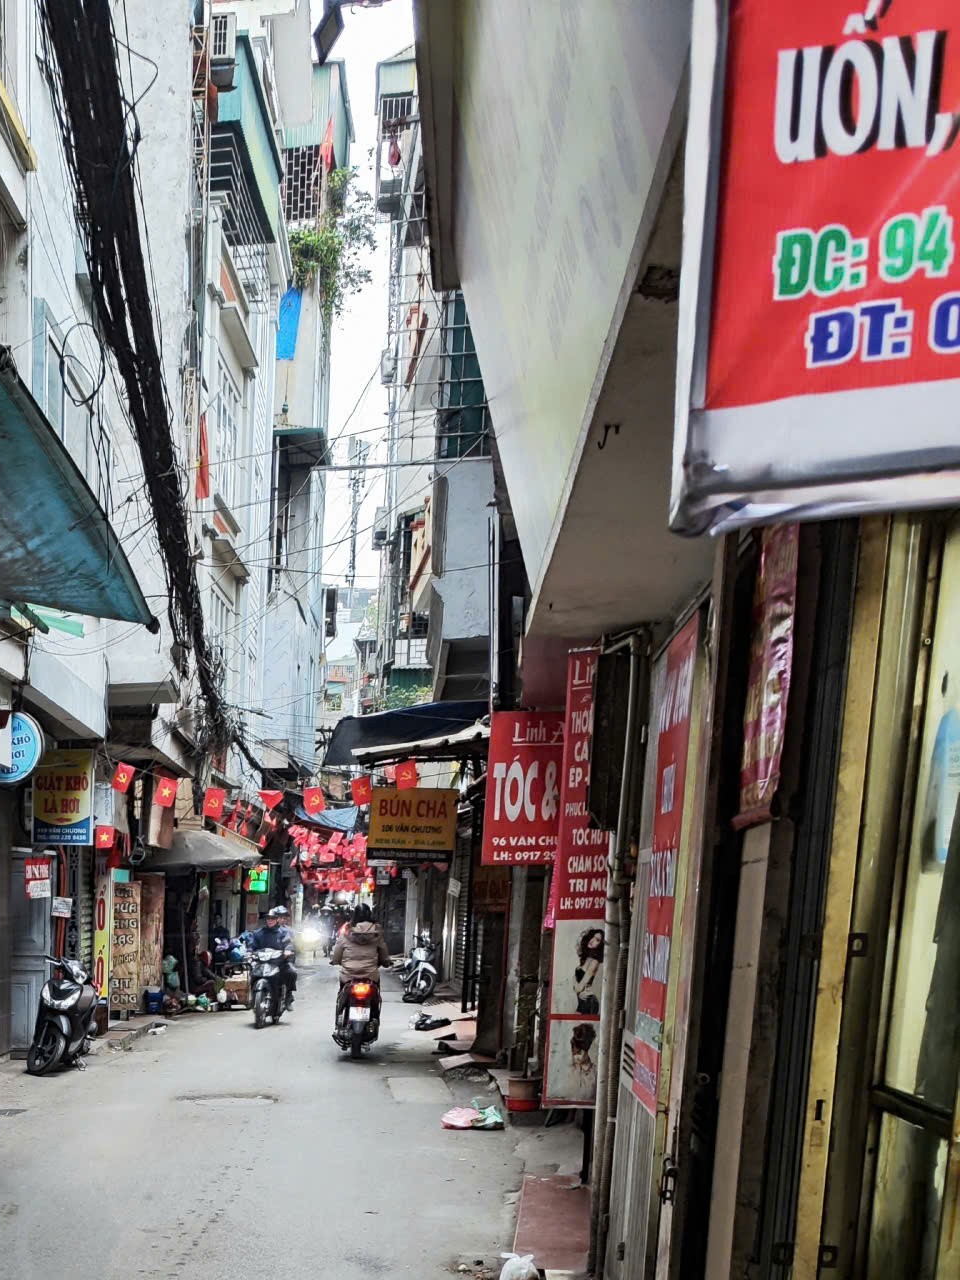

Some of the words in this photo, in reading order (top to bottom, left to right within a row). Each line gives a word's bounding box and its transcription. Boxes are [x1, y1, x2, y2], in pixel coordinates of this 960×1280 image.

[774, 223, 868, 300] ĐC:
[879, 206, 954, 283] 94
[805, 298, 914, 368] ĐT:
[493, 754, 539, 822] TÓC
[378, 795, 412, 817] BÚN
[416, 794, 448, 818] CHẢ
[492, 836, 507, 846] 96
[493, 850, 512, 861] LH:
[515, 851, 541, 861] 0917
[560, 896, 573, 910] LH:
[574, 896, 593, 910] 0917
